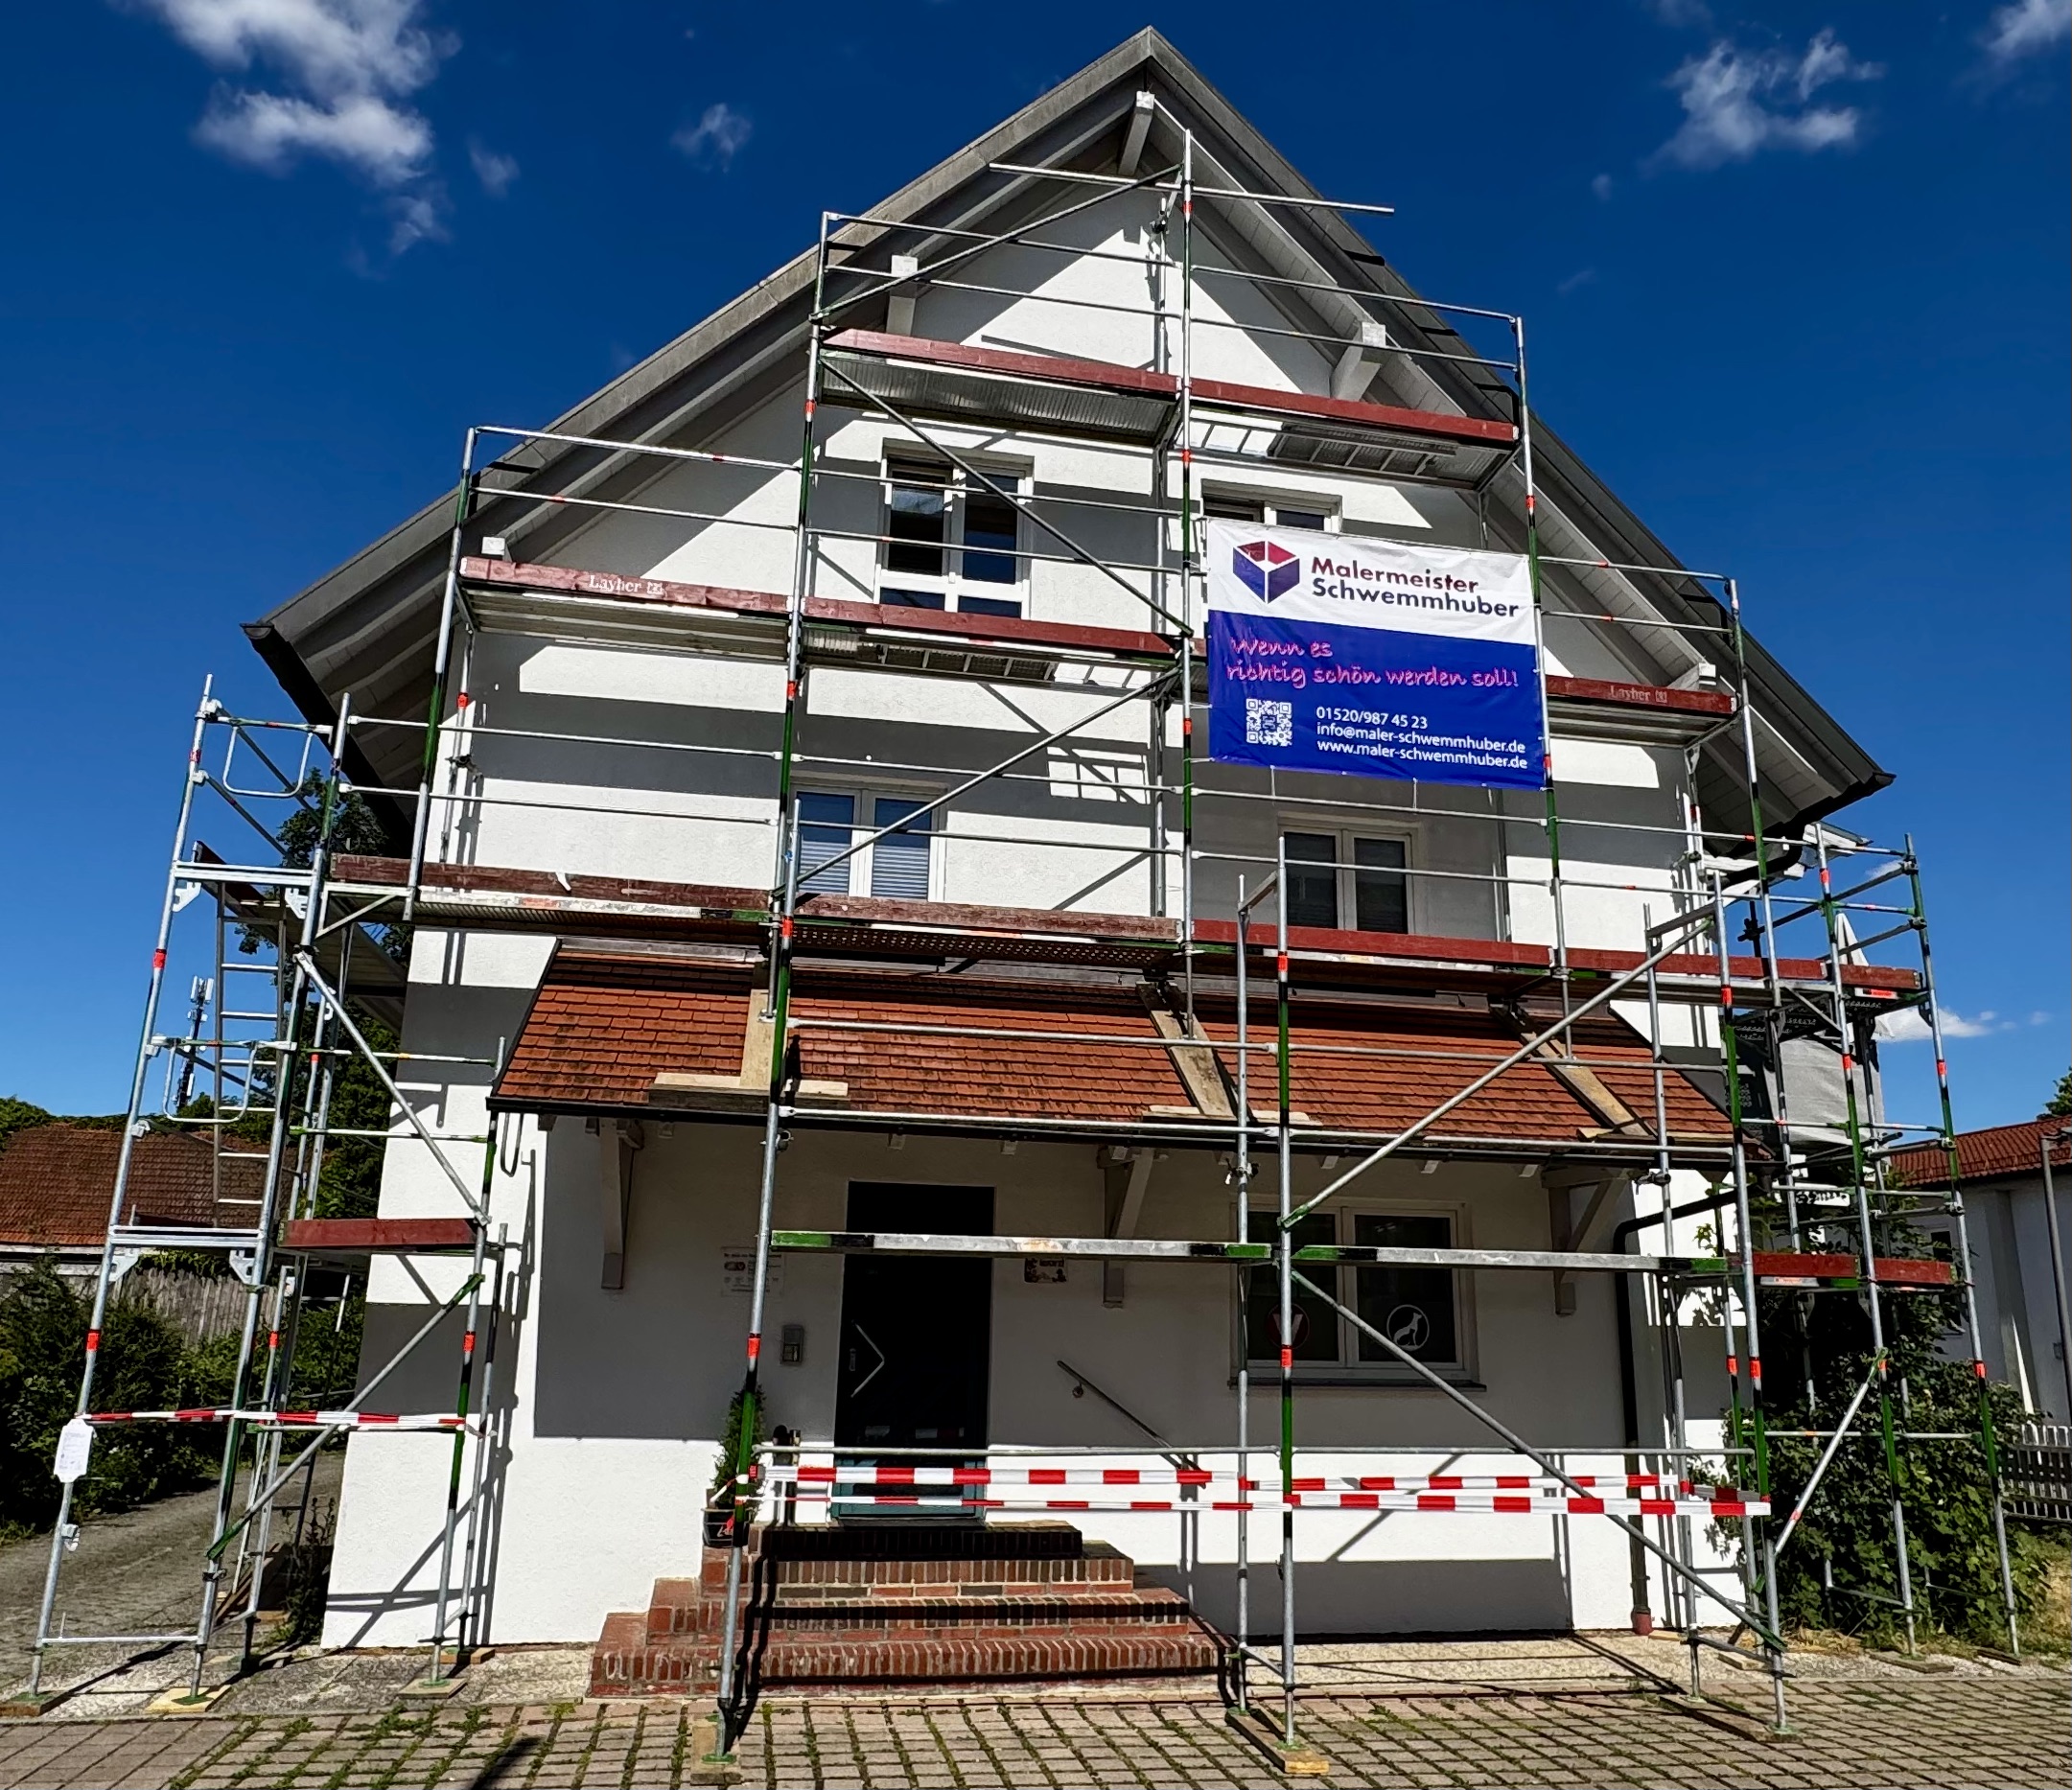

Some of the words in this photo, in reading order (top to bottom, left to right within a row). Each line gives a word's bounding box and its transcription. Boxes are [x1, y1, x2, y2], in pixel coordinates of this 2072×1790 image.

[588, 574, 642, 593] Layher
[1311, 556, 1478, 593] Malermeister
[1312, 577, 1519, 617] Schwemmhuber
[1229, 636, 1305, 657] Wenn
[1310, 640, 1334, 658] es
[1226, 658, 1307, 689] richtig
[1313, 663, 1382, 685] schön
[1385, 665, 1468, 687] werden
[1471, 666, 1520, 687] soll!
[1609, 684, 1652, 702] Layher
[1315, 706, 1389, 726] 01520/987
[1390, 713, 1409, 728] 45
[1410, 714, 1429, 730] 23
[1316, 722, 1526, 754] info@maler-schwemmhuber.de
[1316, 739, 1528, 769] www.maler-schwemmhuber.de
